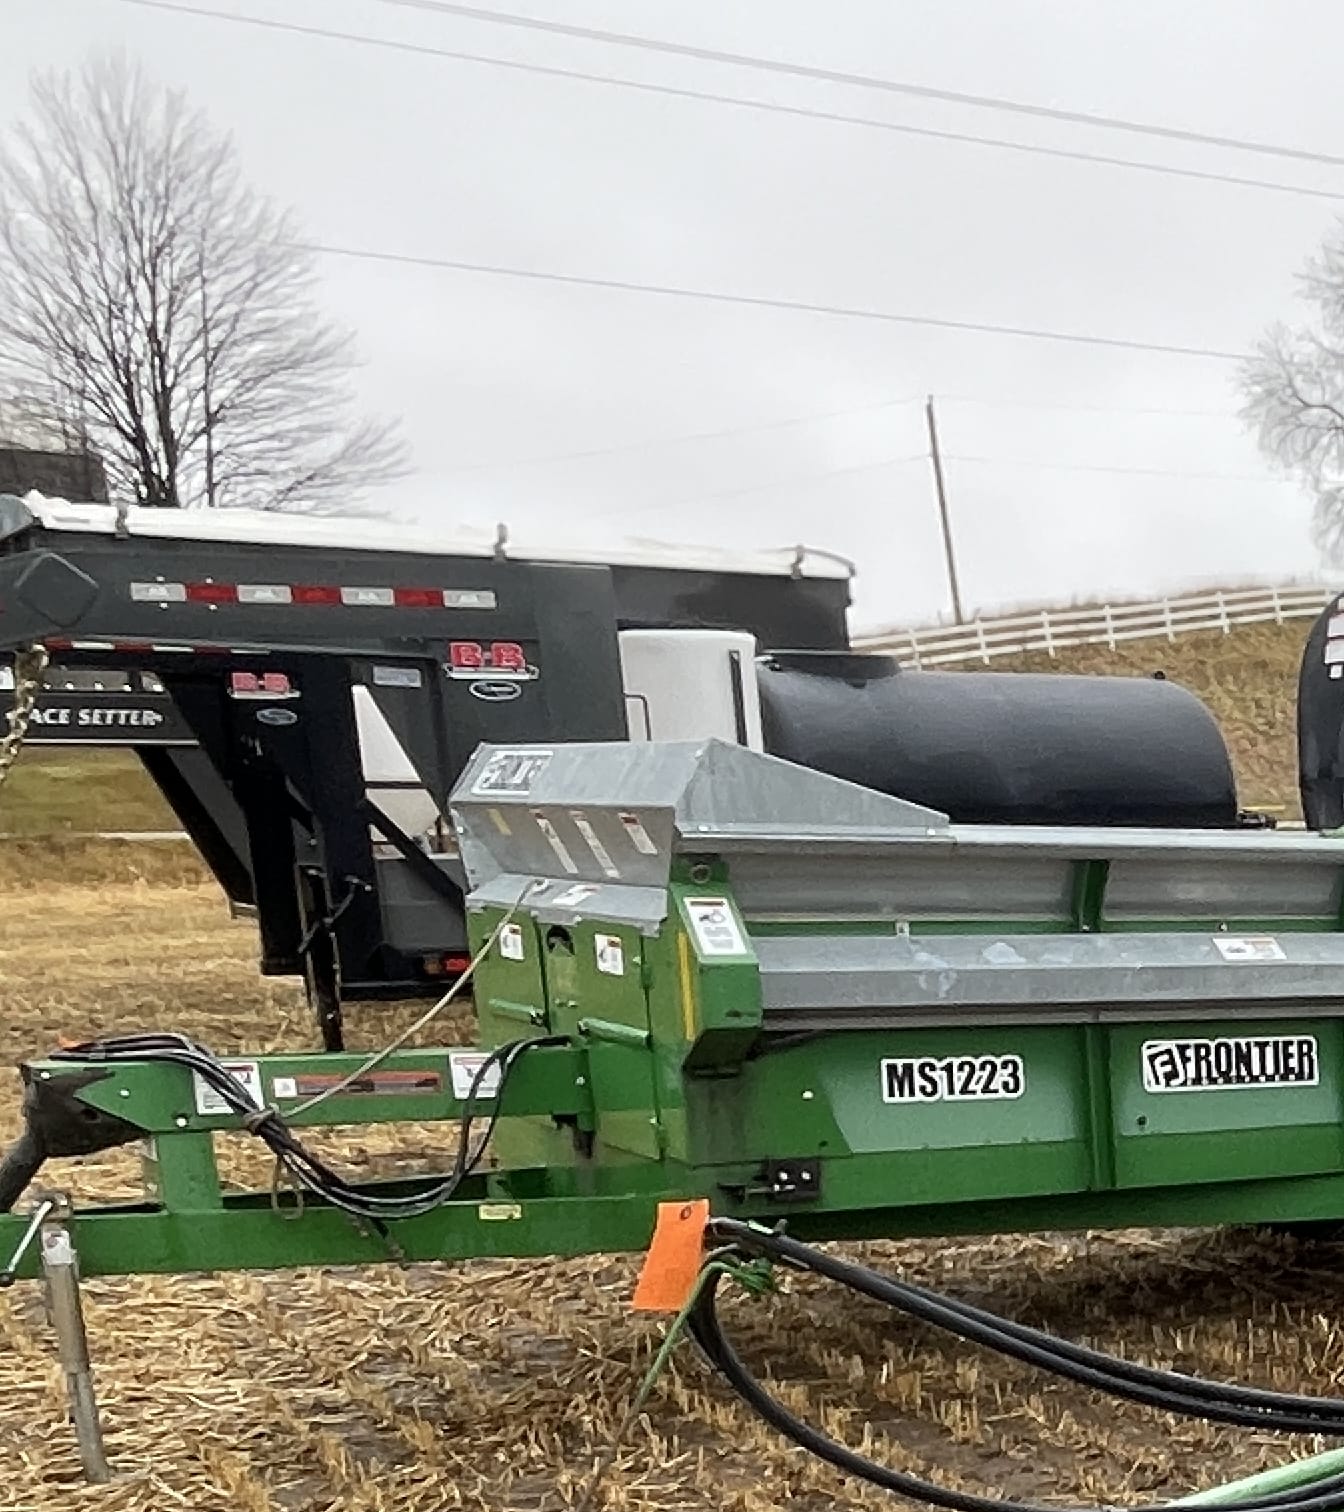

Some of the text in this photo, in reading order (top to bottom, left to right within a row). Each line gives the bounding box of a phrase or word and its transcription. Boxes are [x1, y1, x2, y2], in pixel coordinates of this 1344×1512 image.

[20, 708, 156, 726] ACE SETTER
[886, 1058, 1021, 1098] MS1223
[1175, 1040, 1314, 1086] FRONTIER
